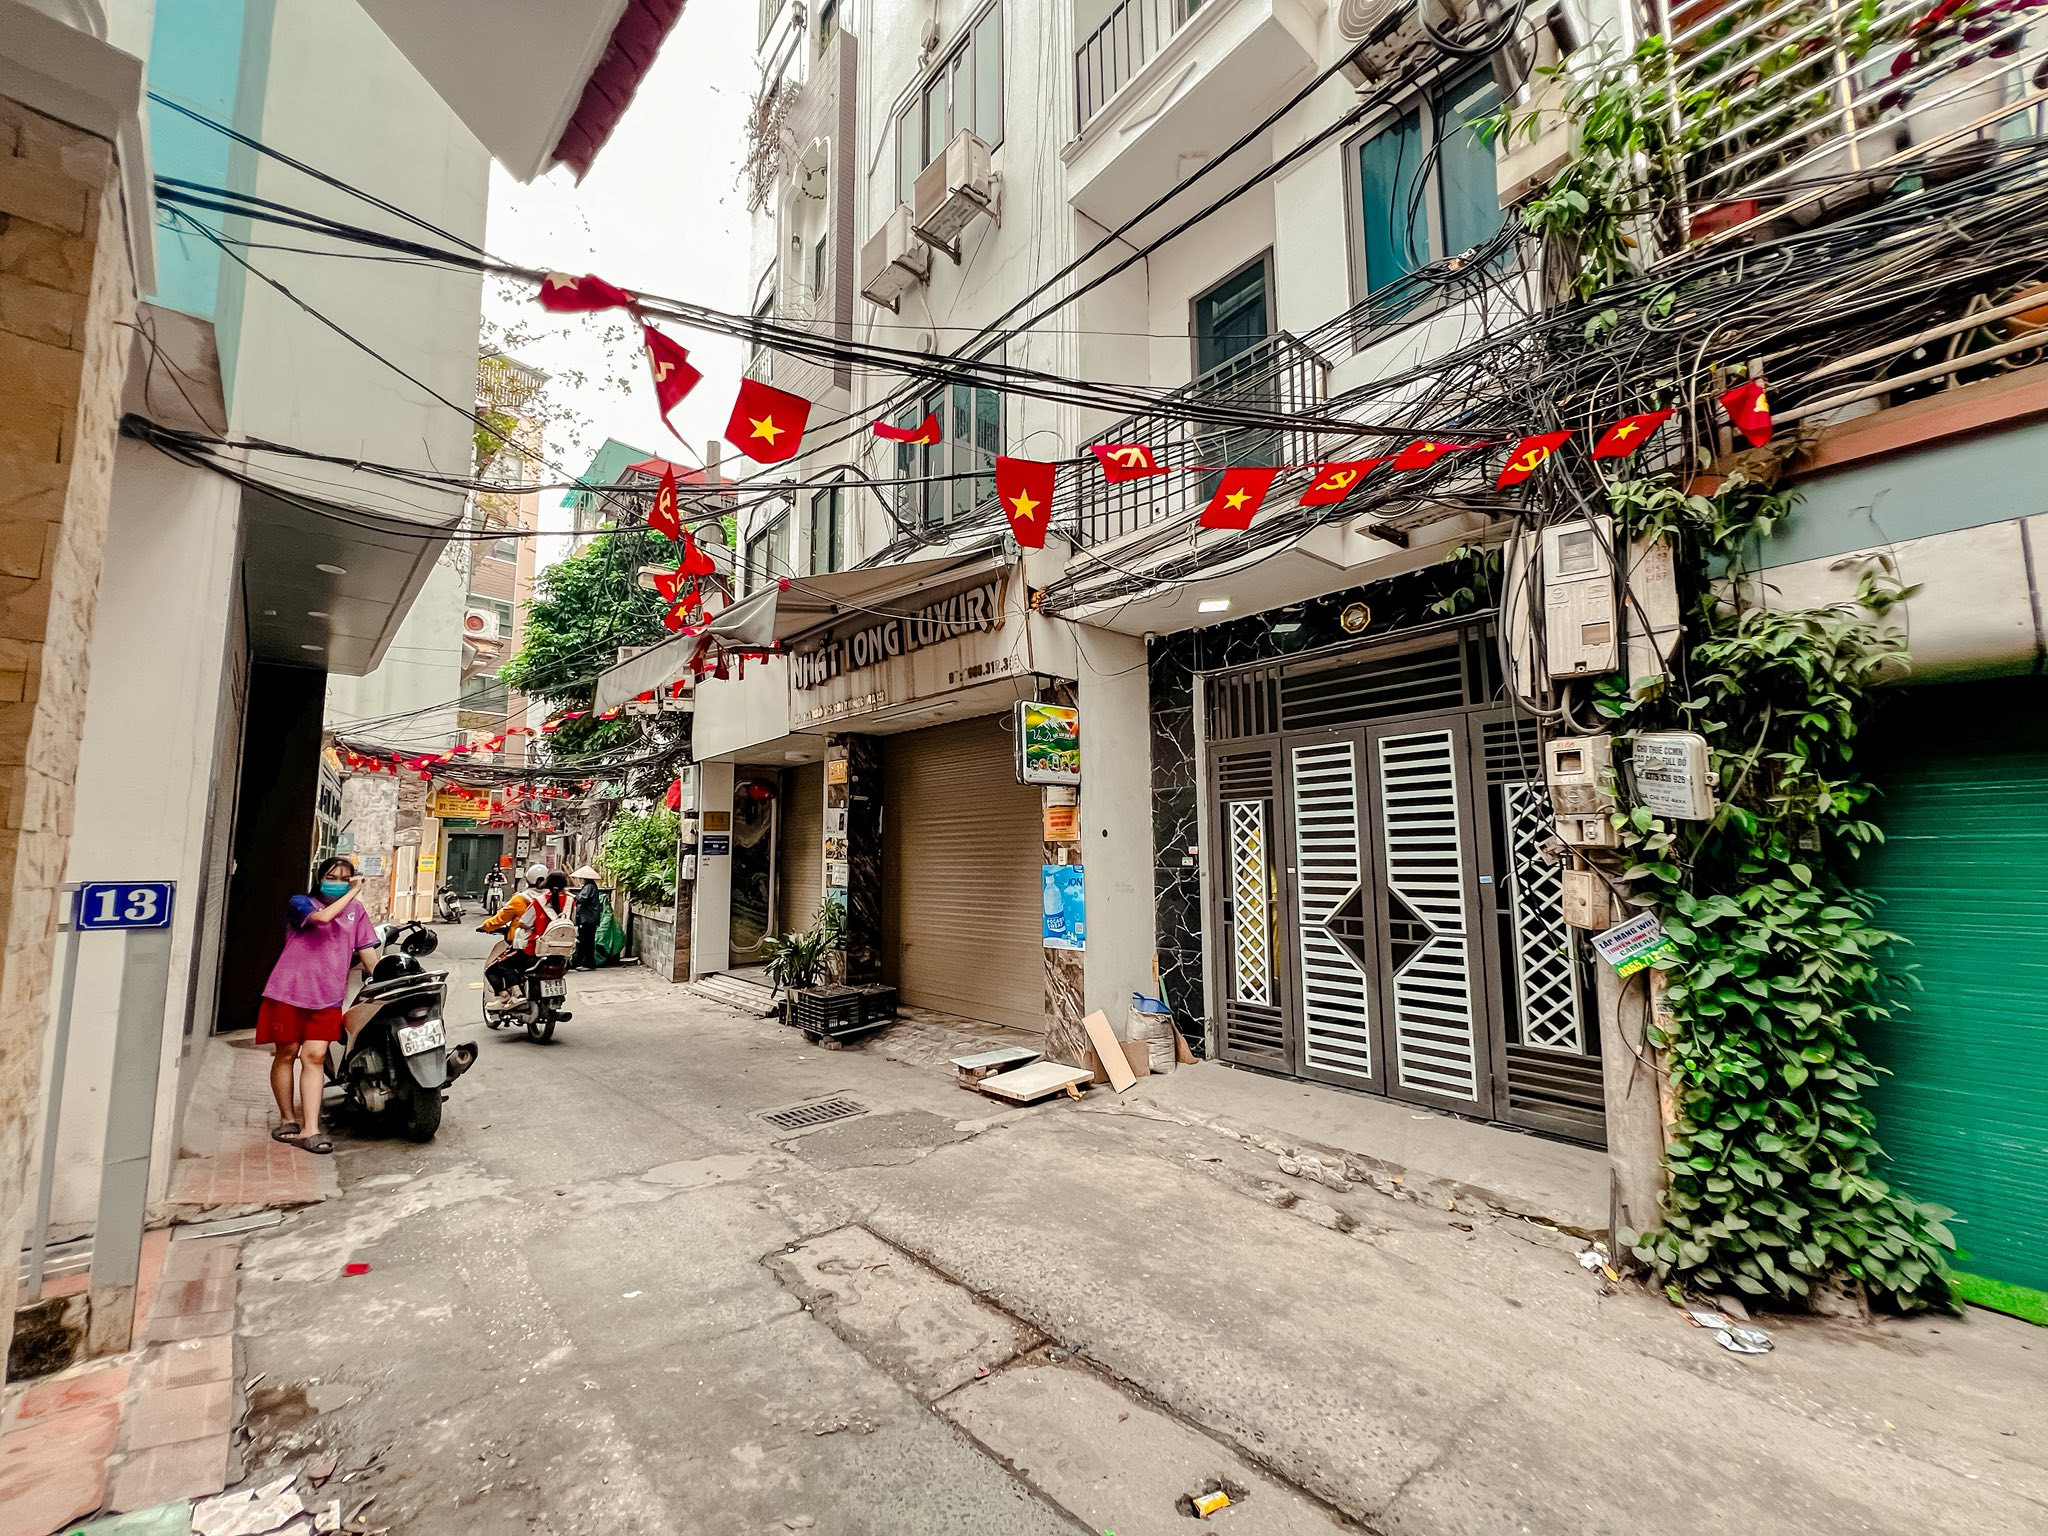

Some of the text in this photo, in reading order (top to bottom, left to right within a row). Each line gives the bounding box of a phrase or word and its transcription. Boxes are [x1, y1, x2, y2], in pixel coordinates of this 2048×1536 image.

[906, 578, 1008, 651] LUXURY
[1068, 878, 1082, 886] ION
[93, 889, 157, 921] 13
[1637, 919, 1656, 931] WIFI
[1619, 936, 1656, 957] CAMERA
